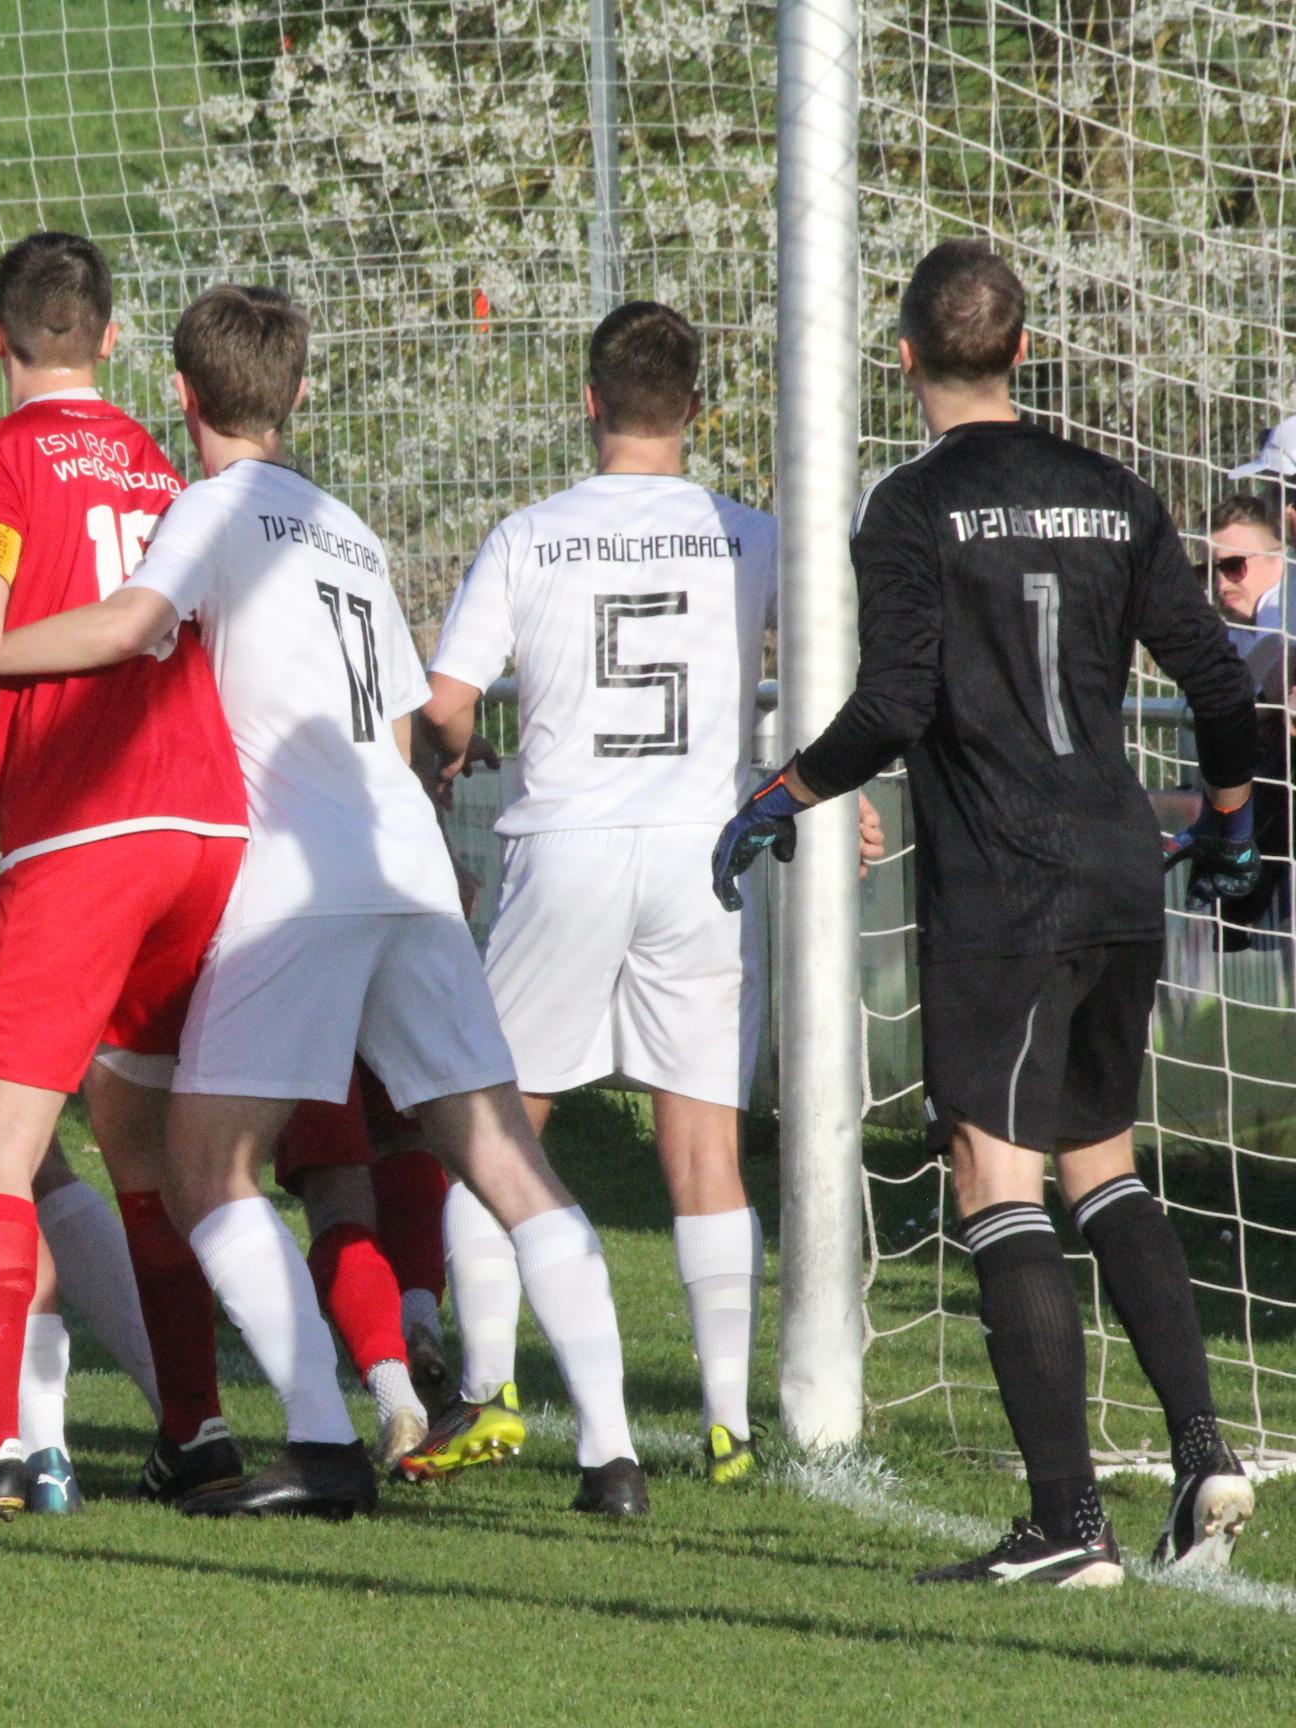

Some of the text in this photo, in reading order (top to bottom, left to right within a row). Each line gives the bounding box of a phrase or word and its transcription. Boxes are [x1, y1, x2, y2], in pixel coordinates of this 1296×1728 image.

[36, 429, 130, 468] tsv 1860
[258, 515, 385, 579] TV 21 BÜCHENBA
[949, 510, 978, 542] TV
[979, 507, 1007, 539] 21
[534, 533, 742, 568] TV 21 BÜCHENBACH
[594, 590, 689, 758] 5
[1023, 573, 1075, 756] 1
